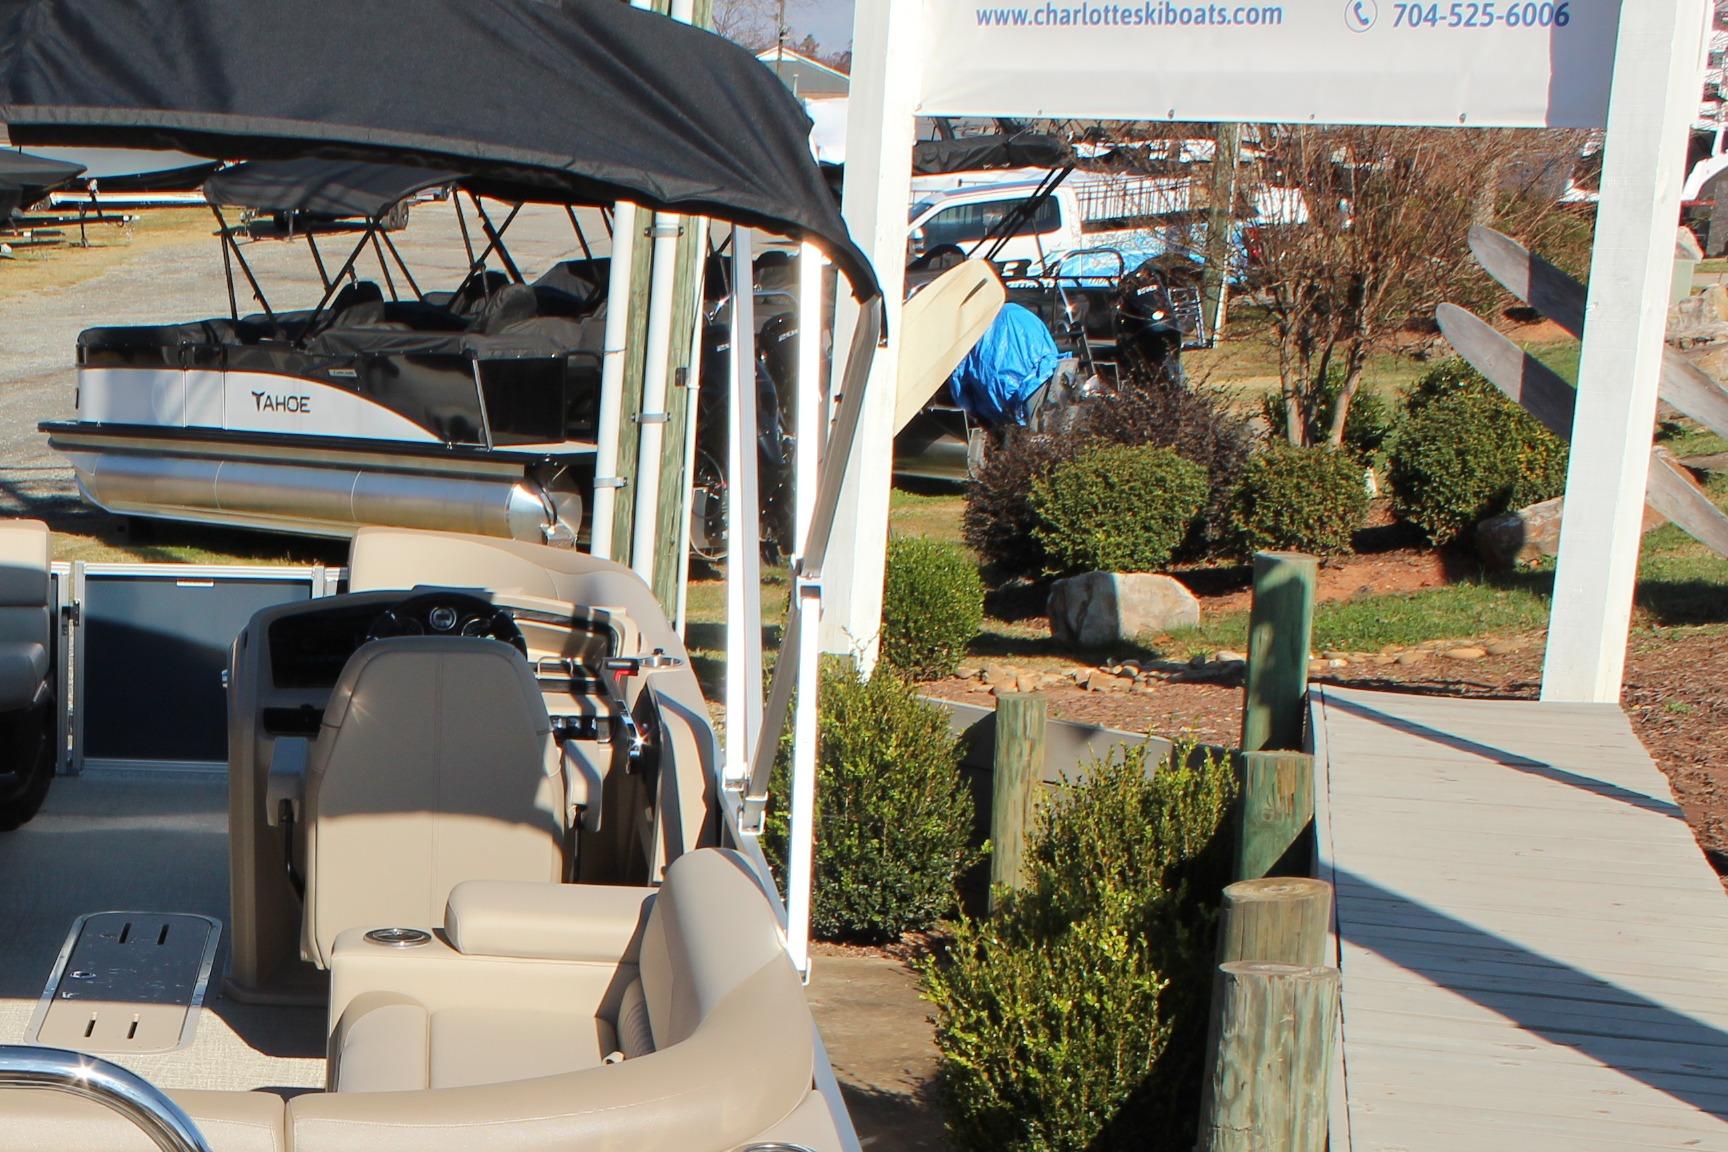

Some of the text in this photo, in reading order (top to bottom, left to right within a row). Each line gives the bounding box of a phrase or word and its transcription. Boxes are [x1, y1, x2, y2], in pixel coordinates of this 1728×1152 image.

[975, 1, 1571, 29] www.charlotteskiboats.com 704-525-6006
[251, 390, 311, 413] TAHOE
